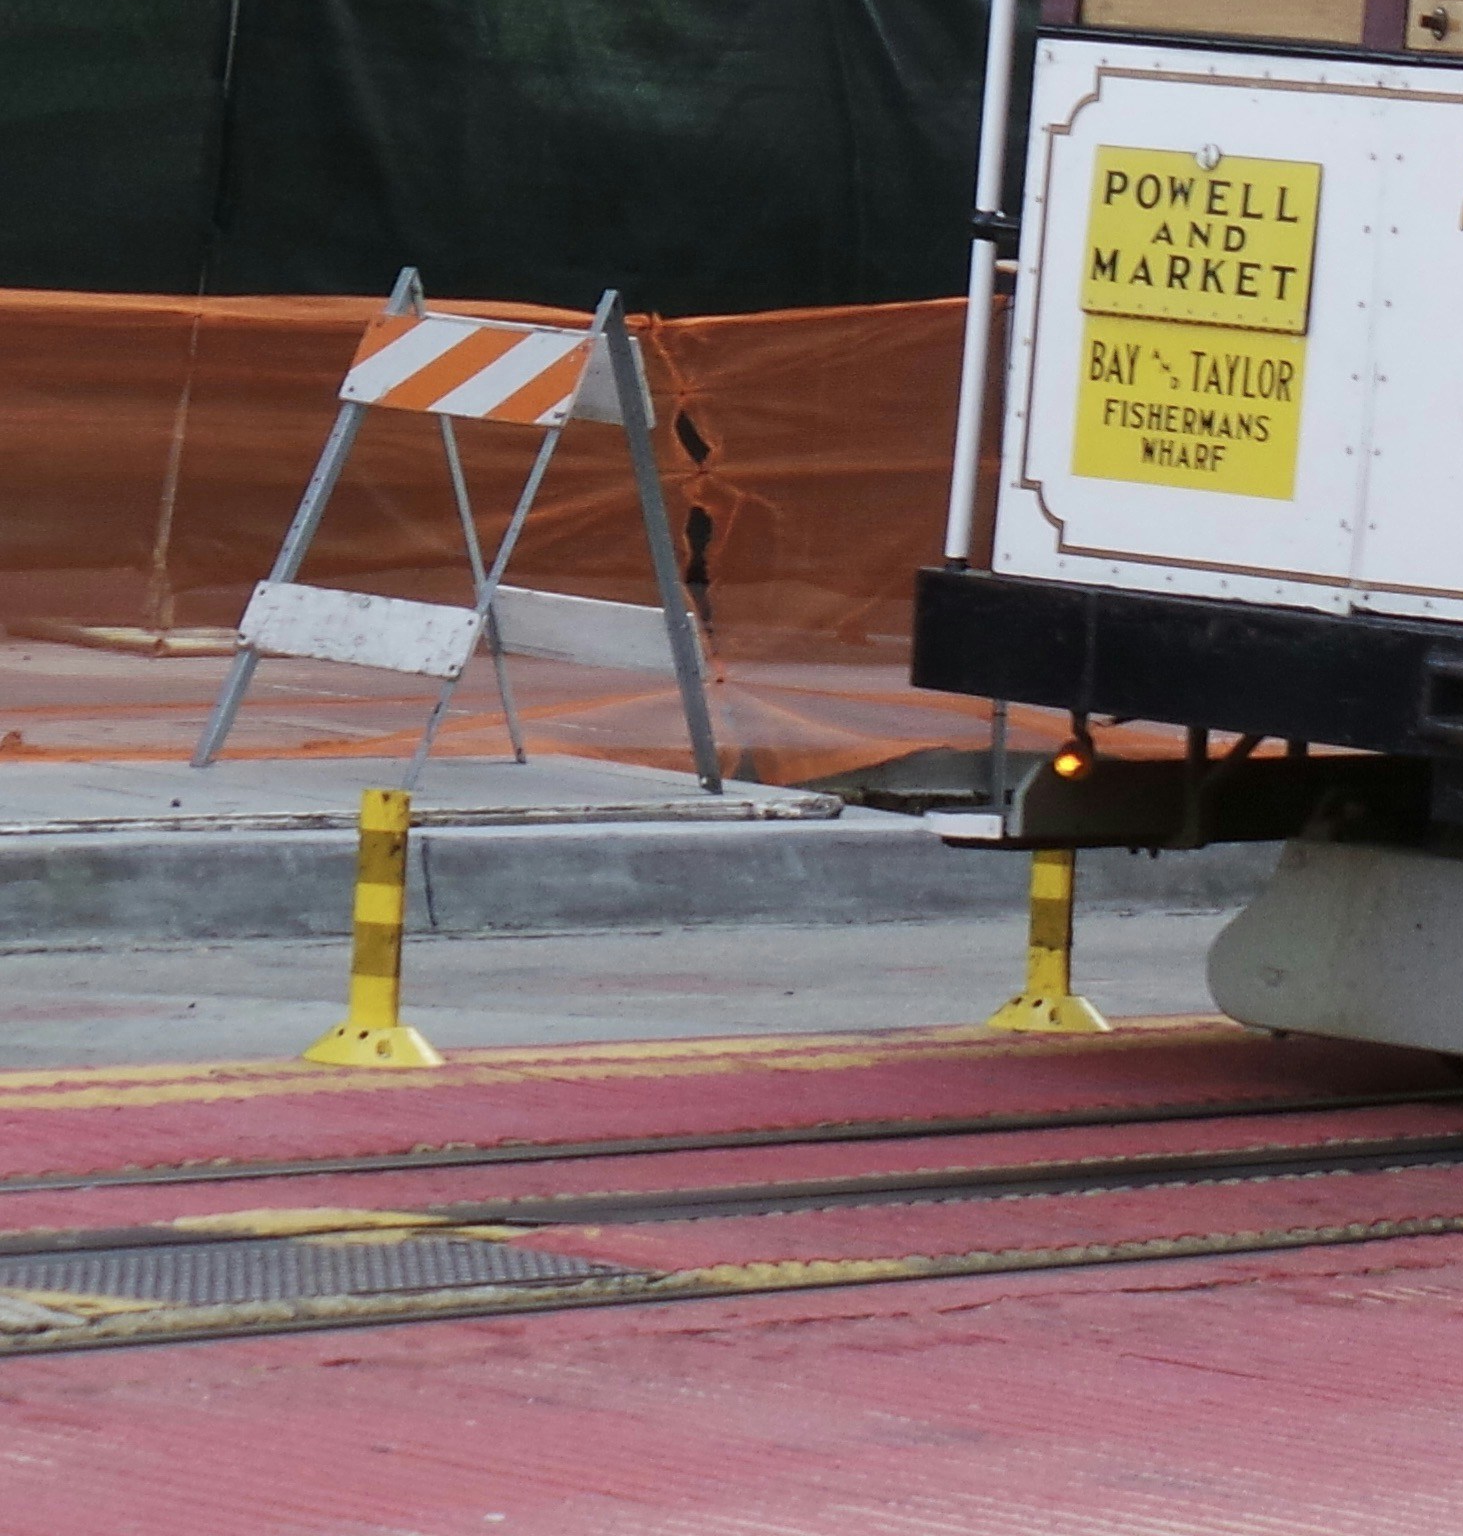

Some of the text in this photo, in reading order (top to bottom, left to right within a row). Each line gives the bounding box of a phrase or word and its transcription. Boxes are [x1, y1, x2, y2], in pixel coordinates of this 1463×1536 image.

[1103, 169, 1299, 224] POWELL
[1151, 221, 1247, 253] AND
[1090, 246, 1298, 302] MARKET
[1088, 339, 1143, 386] BAY
[1190, 349, 1296, 403] TAYLOR
[1103, 397, 1272, 443] FISHERMANS
[1140, 436, 1227, 473] WHARF
